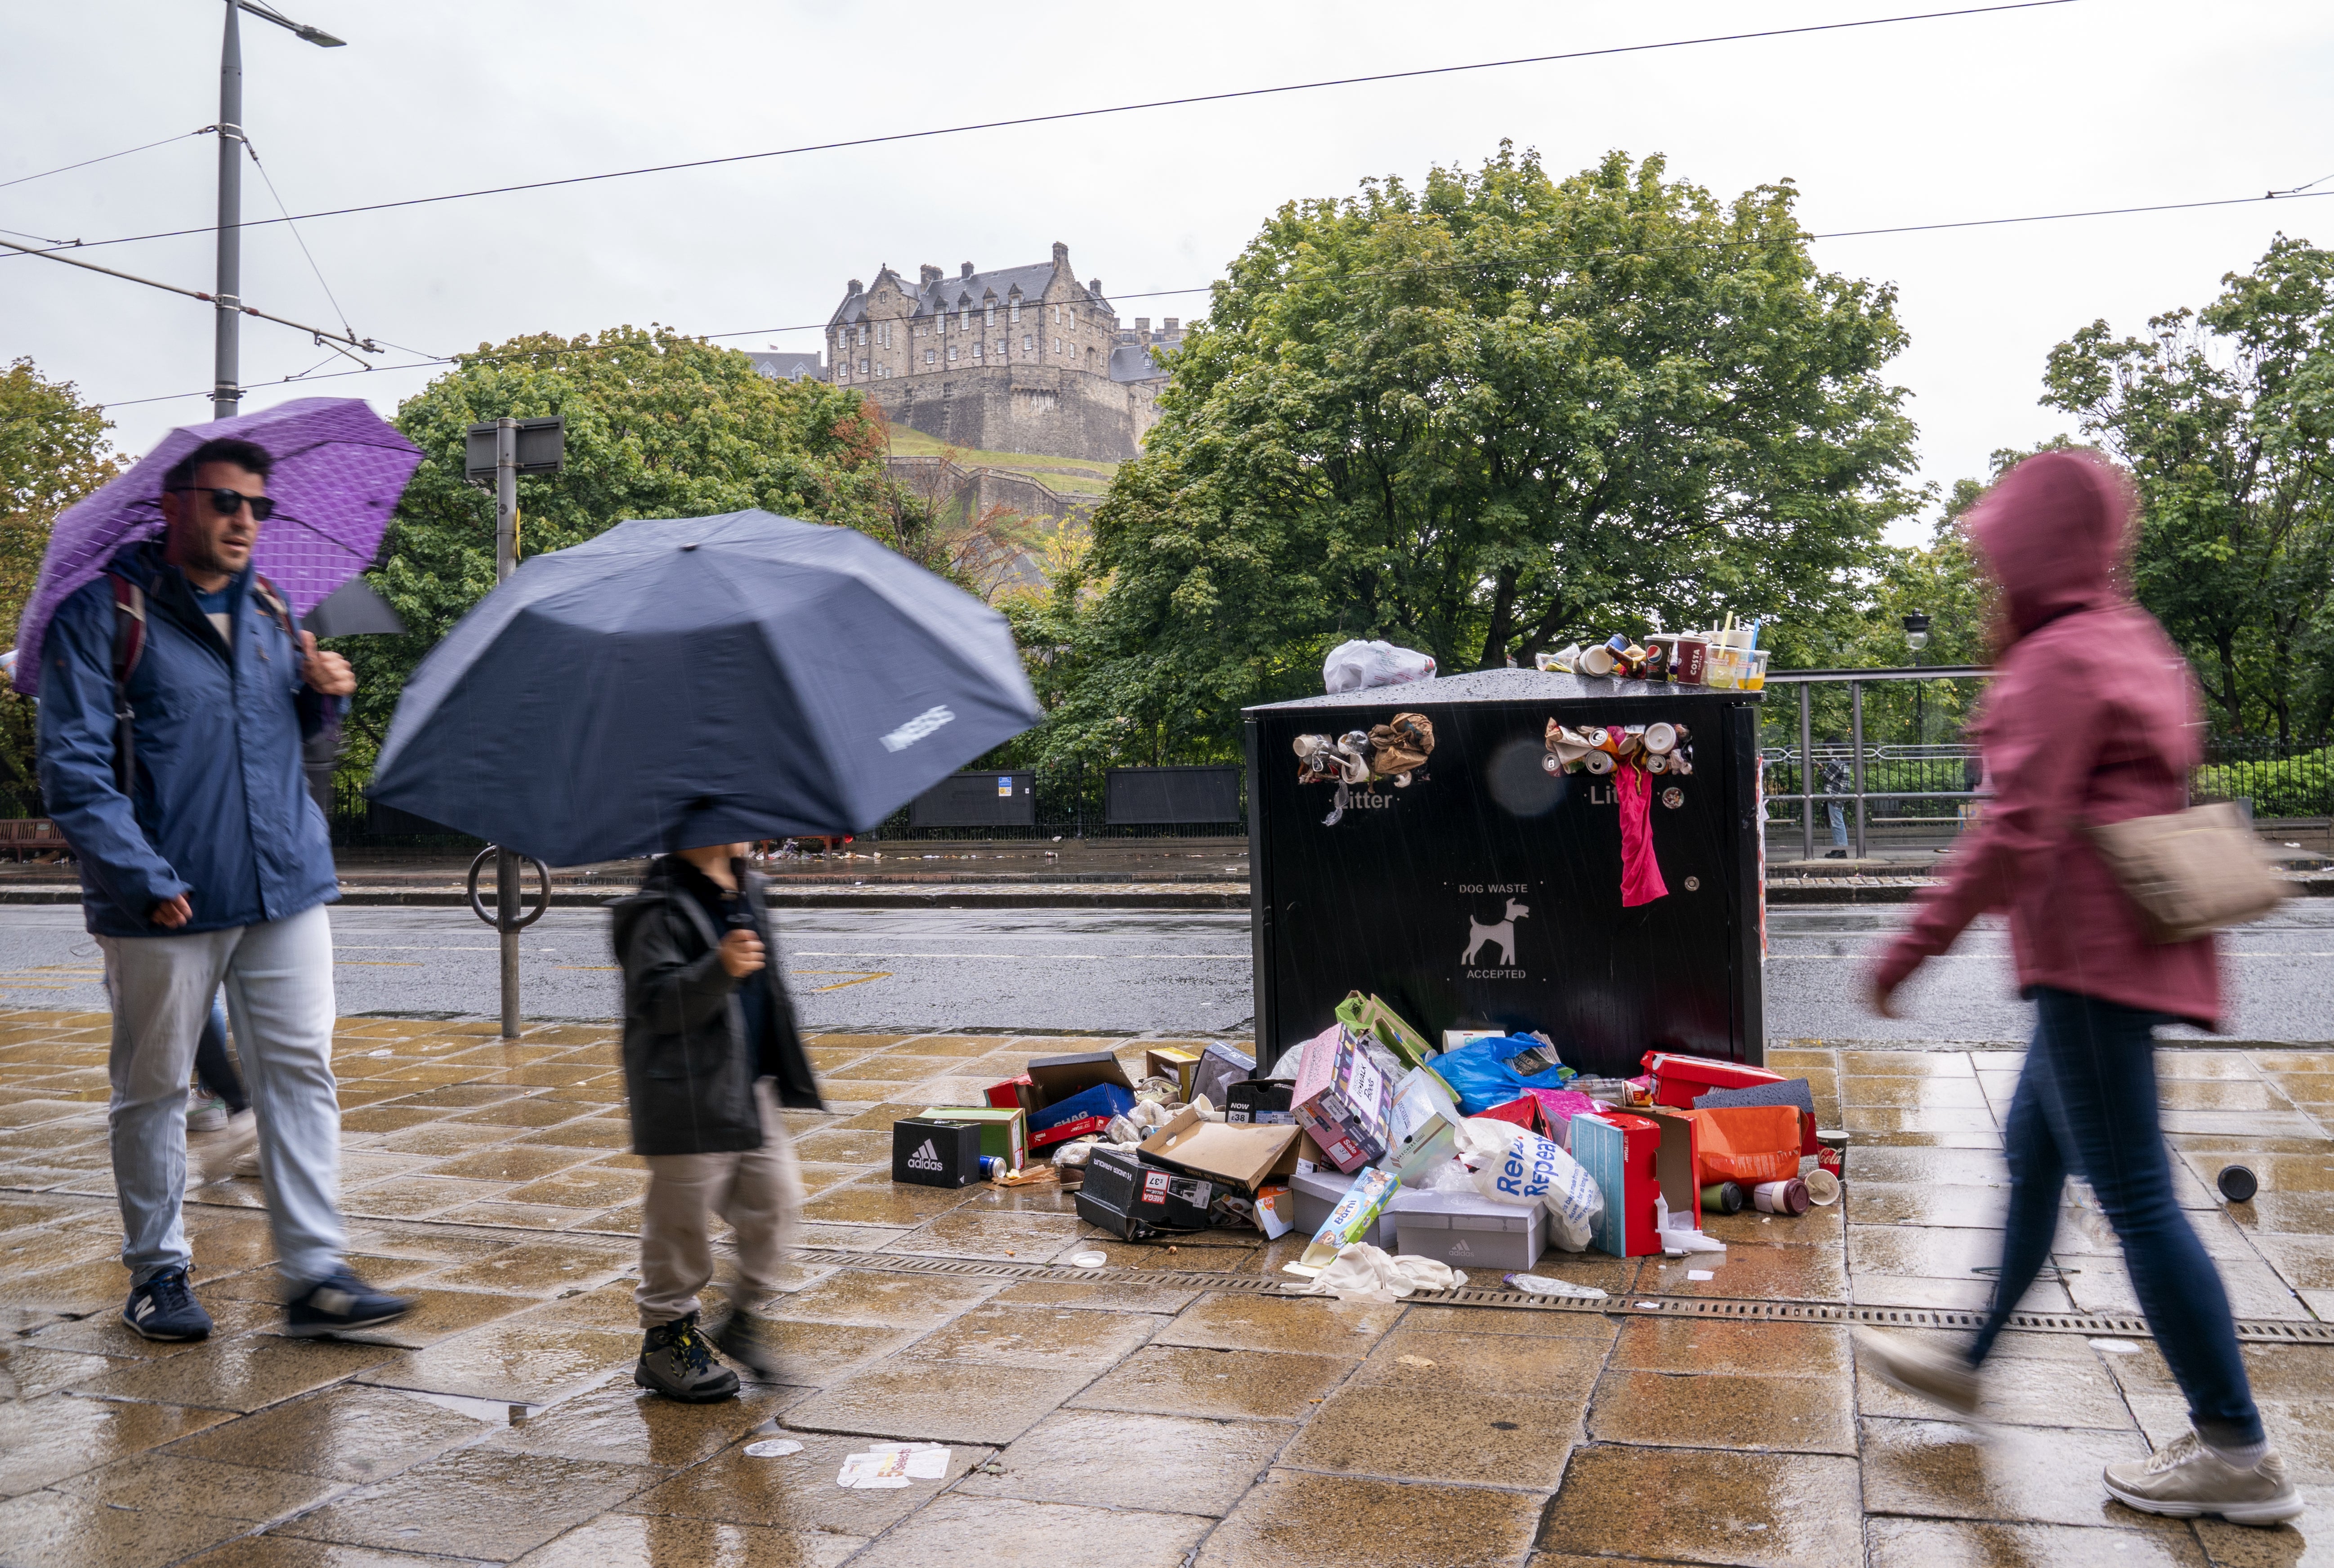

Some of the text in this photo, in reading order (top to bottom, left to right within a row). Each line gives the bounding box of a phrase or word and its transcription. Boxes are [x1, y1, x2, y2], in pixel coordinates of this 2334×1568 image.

[1690, 649, 1700, 675] COSTA
[1590, 786, 1619, 804] Lit
[1459, 884, 1528, 893] DOG WASTE
[1467, 970, 1526, 979] ACCEPTED
[1518, 1052, 1540, 1069] WREXHA
[1364, 1077, 1374, 1102] Boots
[1231, 1113, 1245, 1122] £38
[1343, 1139, 1357, 1154] Sale
[1396, 1142, 1416, 1160] SKECHERS
[908, 1157, 943, 1171] adidas
[1819, 1148, 1845, 1165] Cola
[1093, 1158, 1128, 1180] UNDER ARMOUR
[1149, 1177, 1163, 1186] £37
[1144, 1193, 1164, 1202] MEGA
[1568, 1204, 1579, 1220] Reuse
[1579, 1177, 1589, 1188] long
[1333, 1200, 1357, 1225] Barni
[1449, 1249, 1475, 1257] adidas
[891, 1448, 912, 1470] Selects
